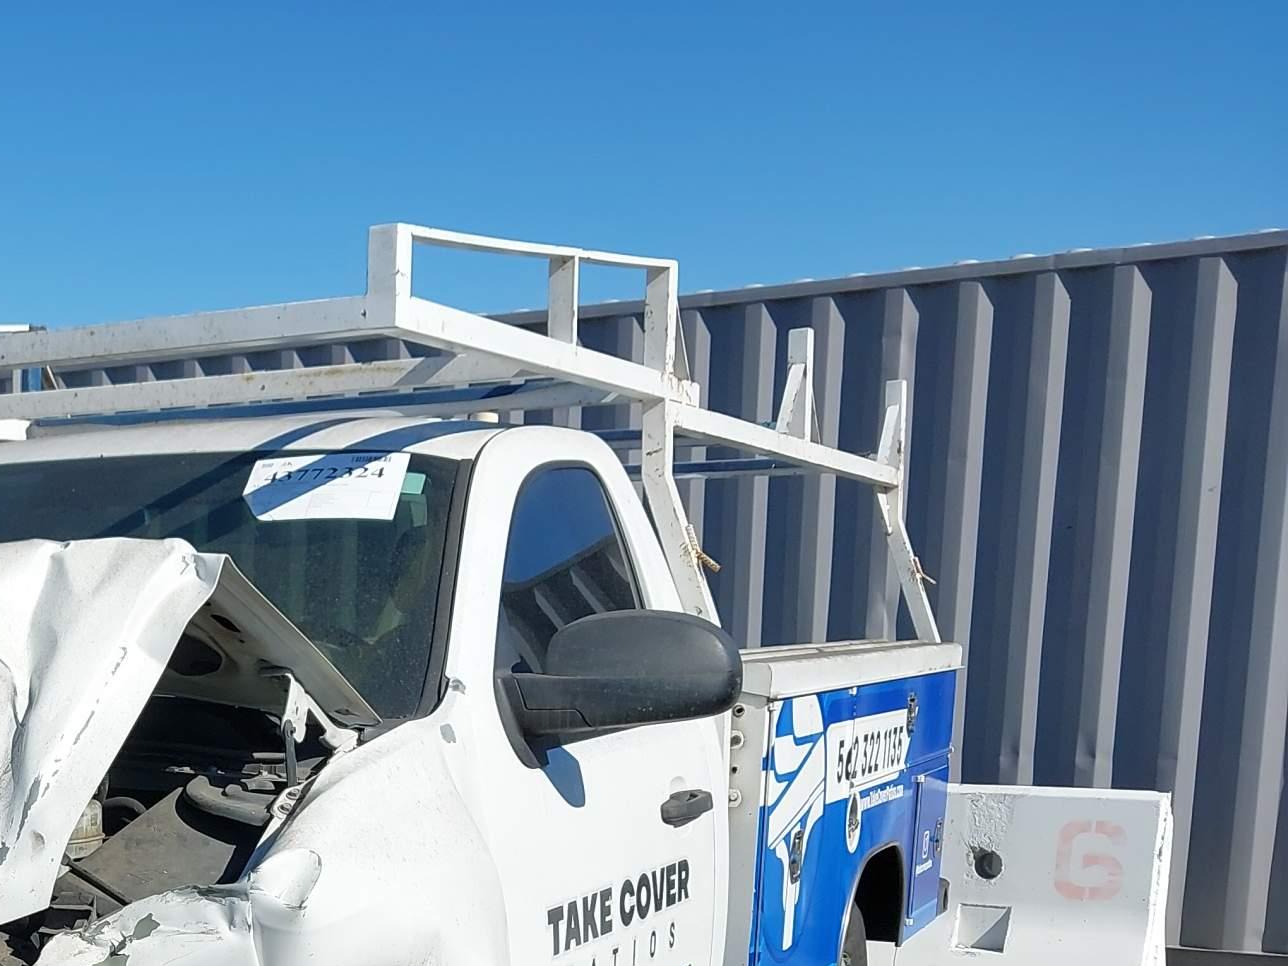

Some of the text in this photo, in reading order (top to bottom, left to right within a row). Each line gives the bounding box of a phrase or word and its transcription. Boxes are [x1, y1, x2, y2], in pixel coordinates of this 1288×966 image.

[264, 465, 385, 484] 43772324
[861, 730, 881, 777] 322
[882, 725, 904, 769] 1135
[1054, 819, 1127, 901] G
[547, 858, 690, 957] TAKE COVER
